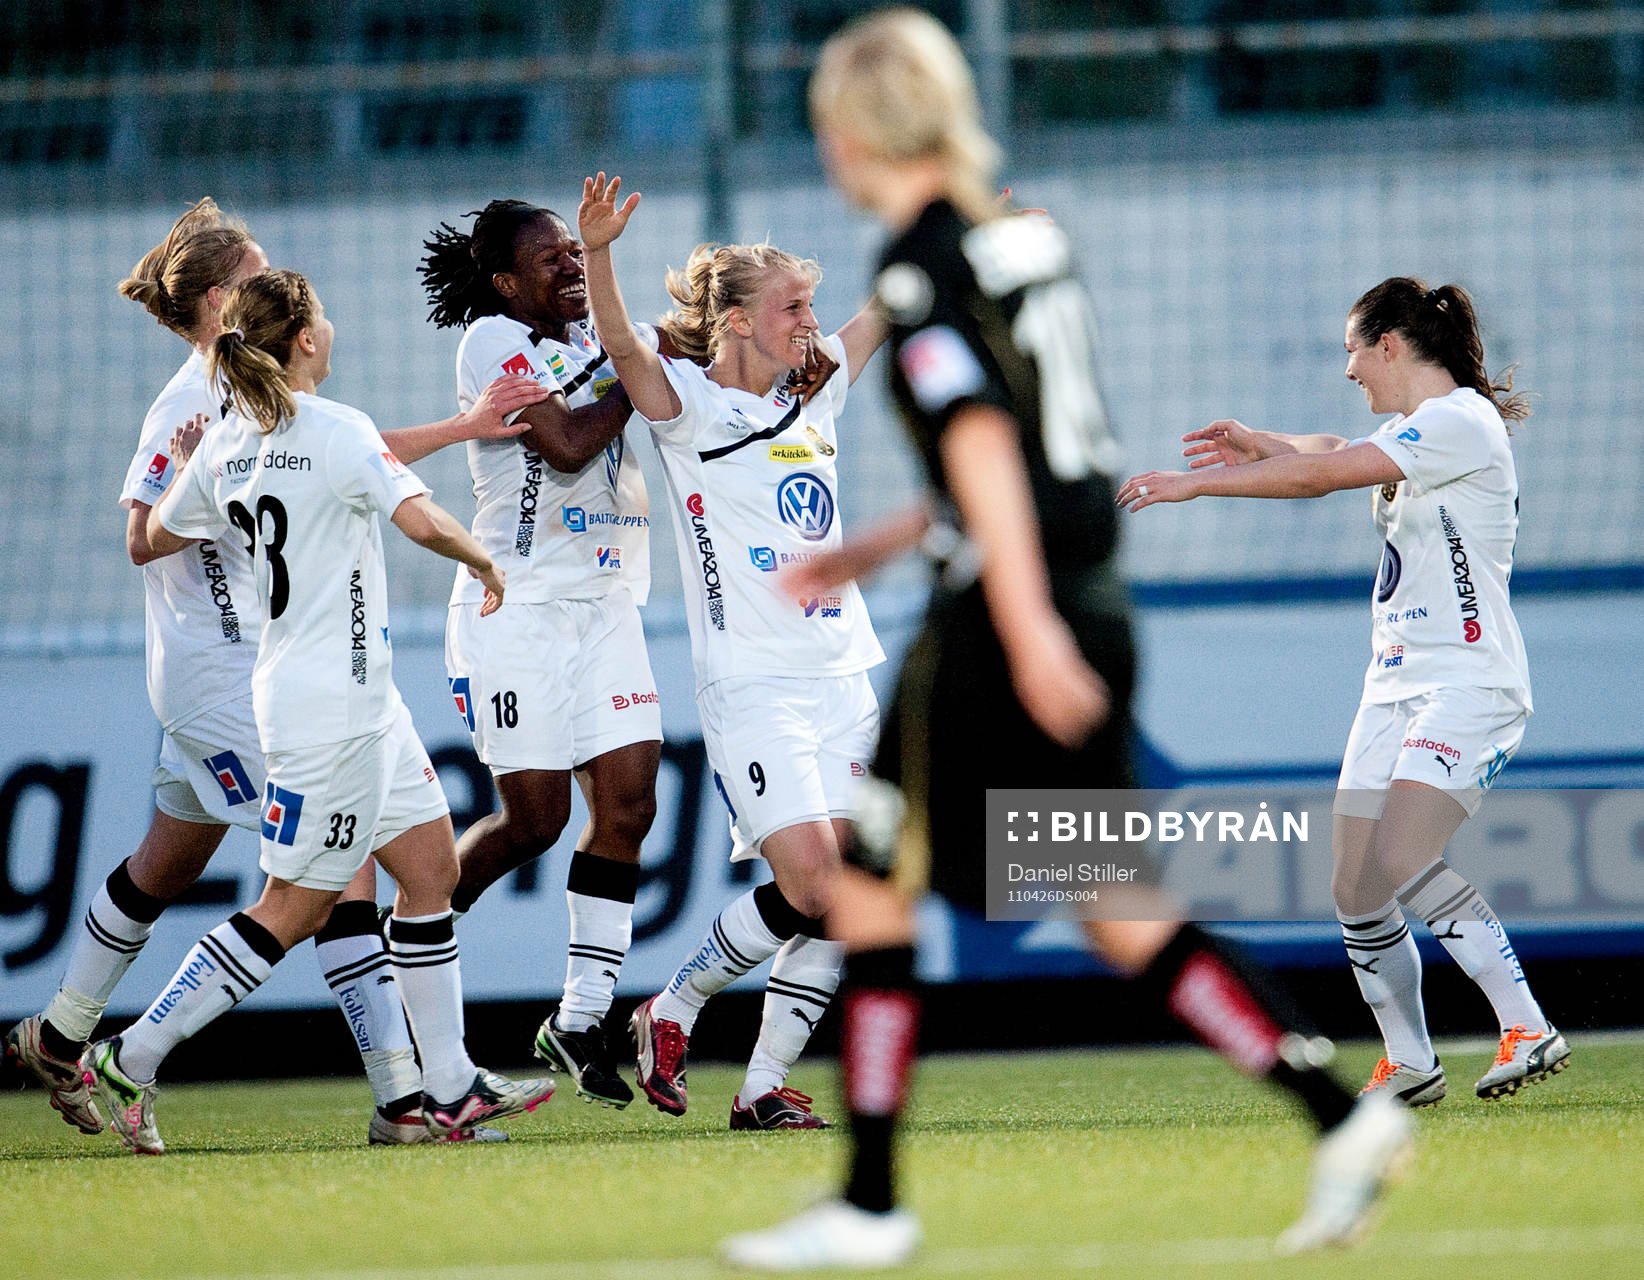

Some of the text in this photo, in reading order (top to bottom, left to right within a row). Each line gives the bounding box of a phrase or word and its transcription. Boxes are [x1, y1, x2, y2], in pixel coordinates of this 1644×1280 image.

[491, 690, 519, 729] 18
[748, 760, 766, 797] 9
[324, 812, 357, 850] 33
[668, 937, 723, 995] Folksam
[148, 952, 217, 1025] Folksam
